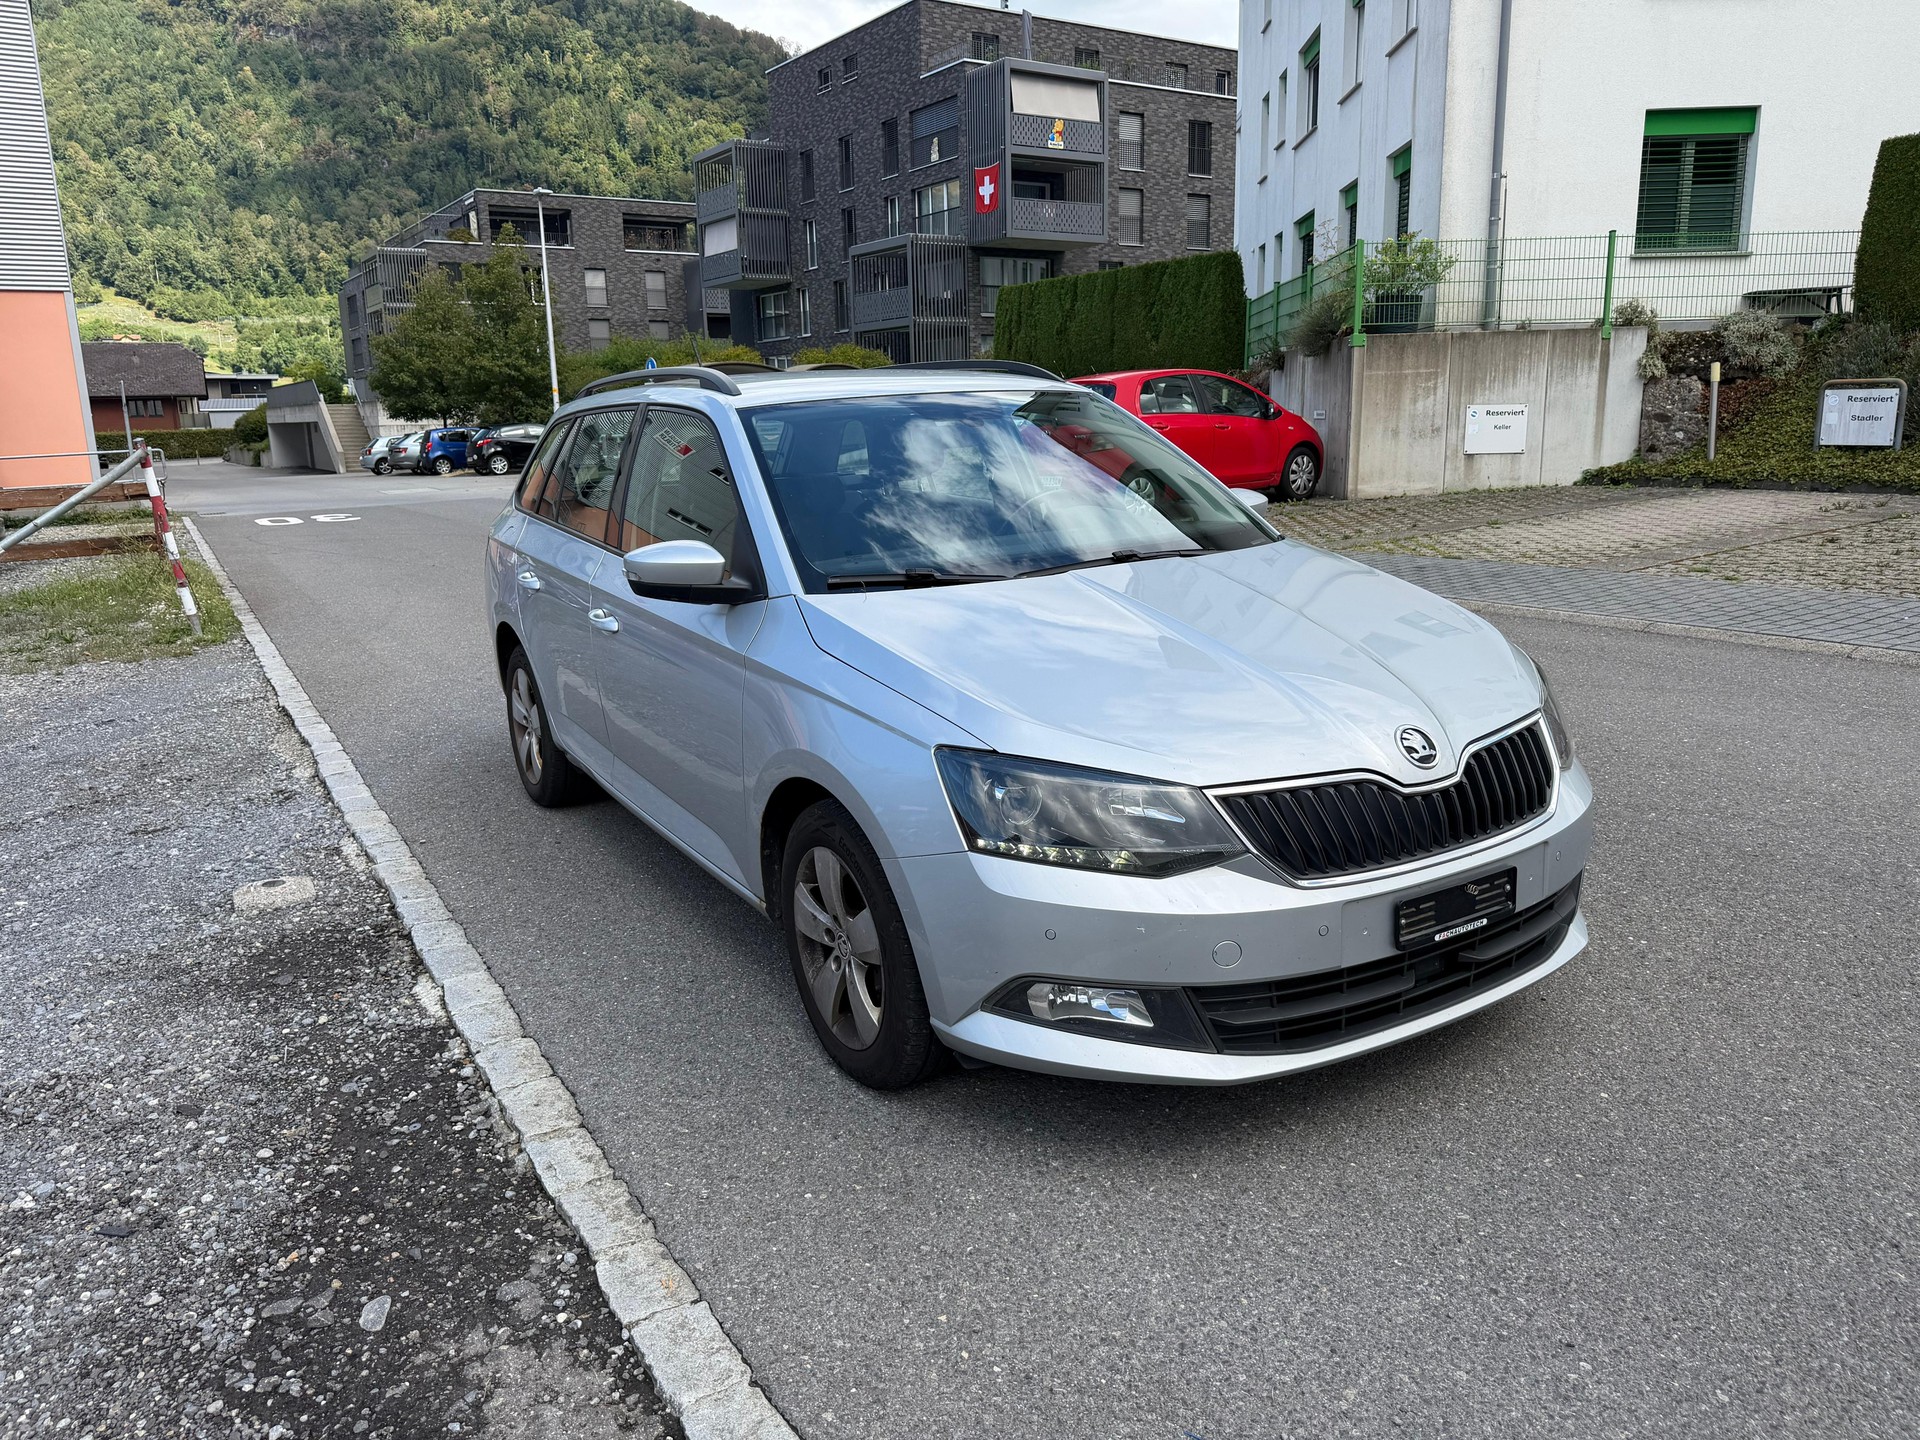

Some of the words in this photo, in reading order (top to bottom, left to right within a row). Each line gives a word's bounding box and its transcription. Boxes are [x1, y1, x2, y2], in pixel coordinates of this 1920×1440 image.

[1847, 394, 1894, 402] Reserviert
[254, 513, 361, 525] 30
[1438, 919, 1483, 939] FACHAUTOTECH
